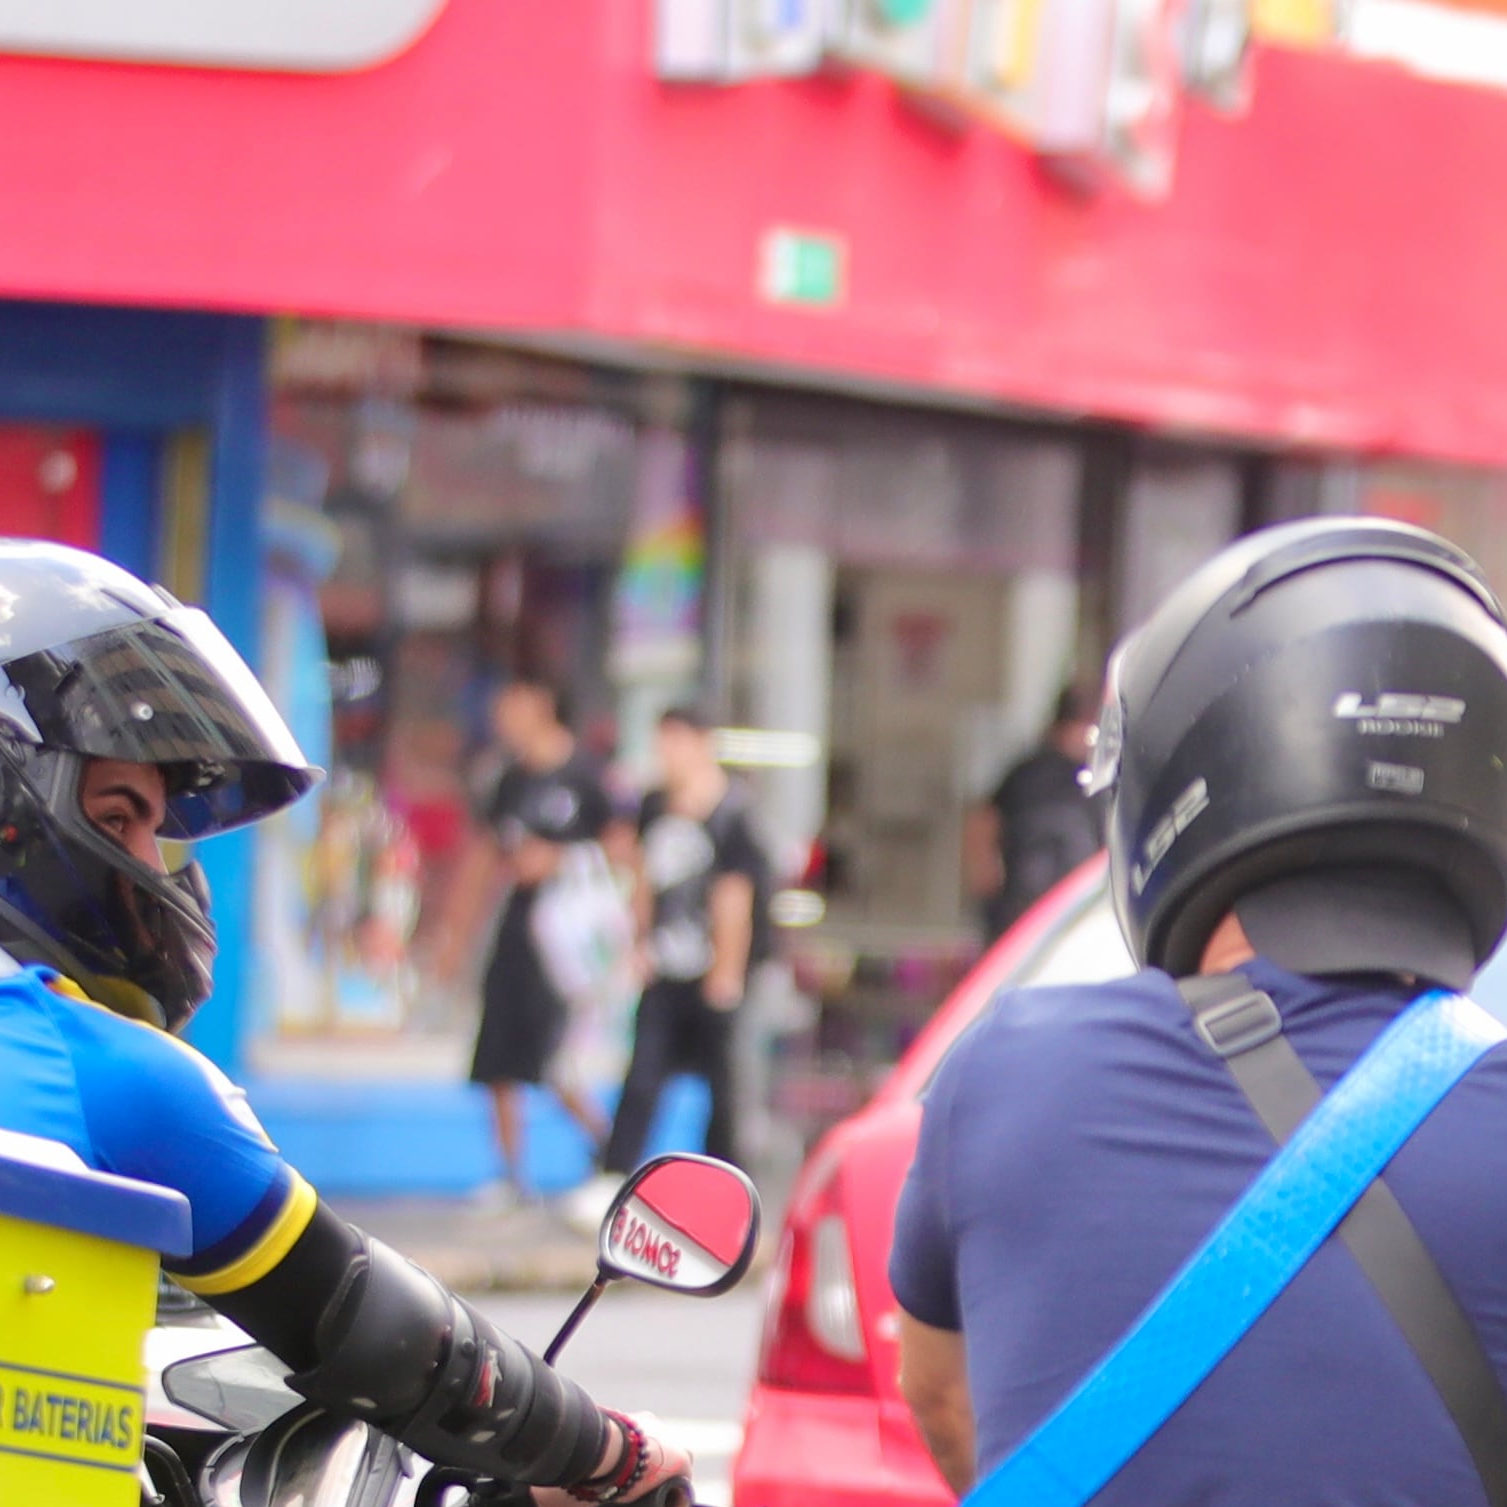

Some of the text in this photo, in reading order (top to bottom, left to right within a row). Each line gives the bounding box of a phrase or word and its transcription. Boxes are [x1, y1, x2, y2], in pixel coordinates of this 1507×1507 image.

[1333, 692, 1466, 724] LS2
[1134, 776, 1210, 896] LS2
[13, 1388, 135, 1450] BATERIAS
